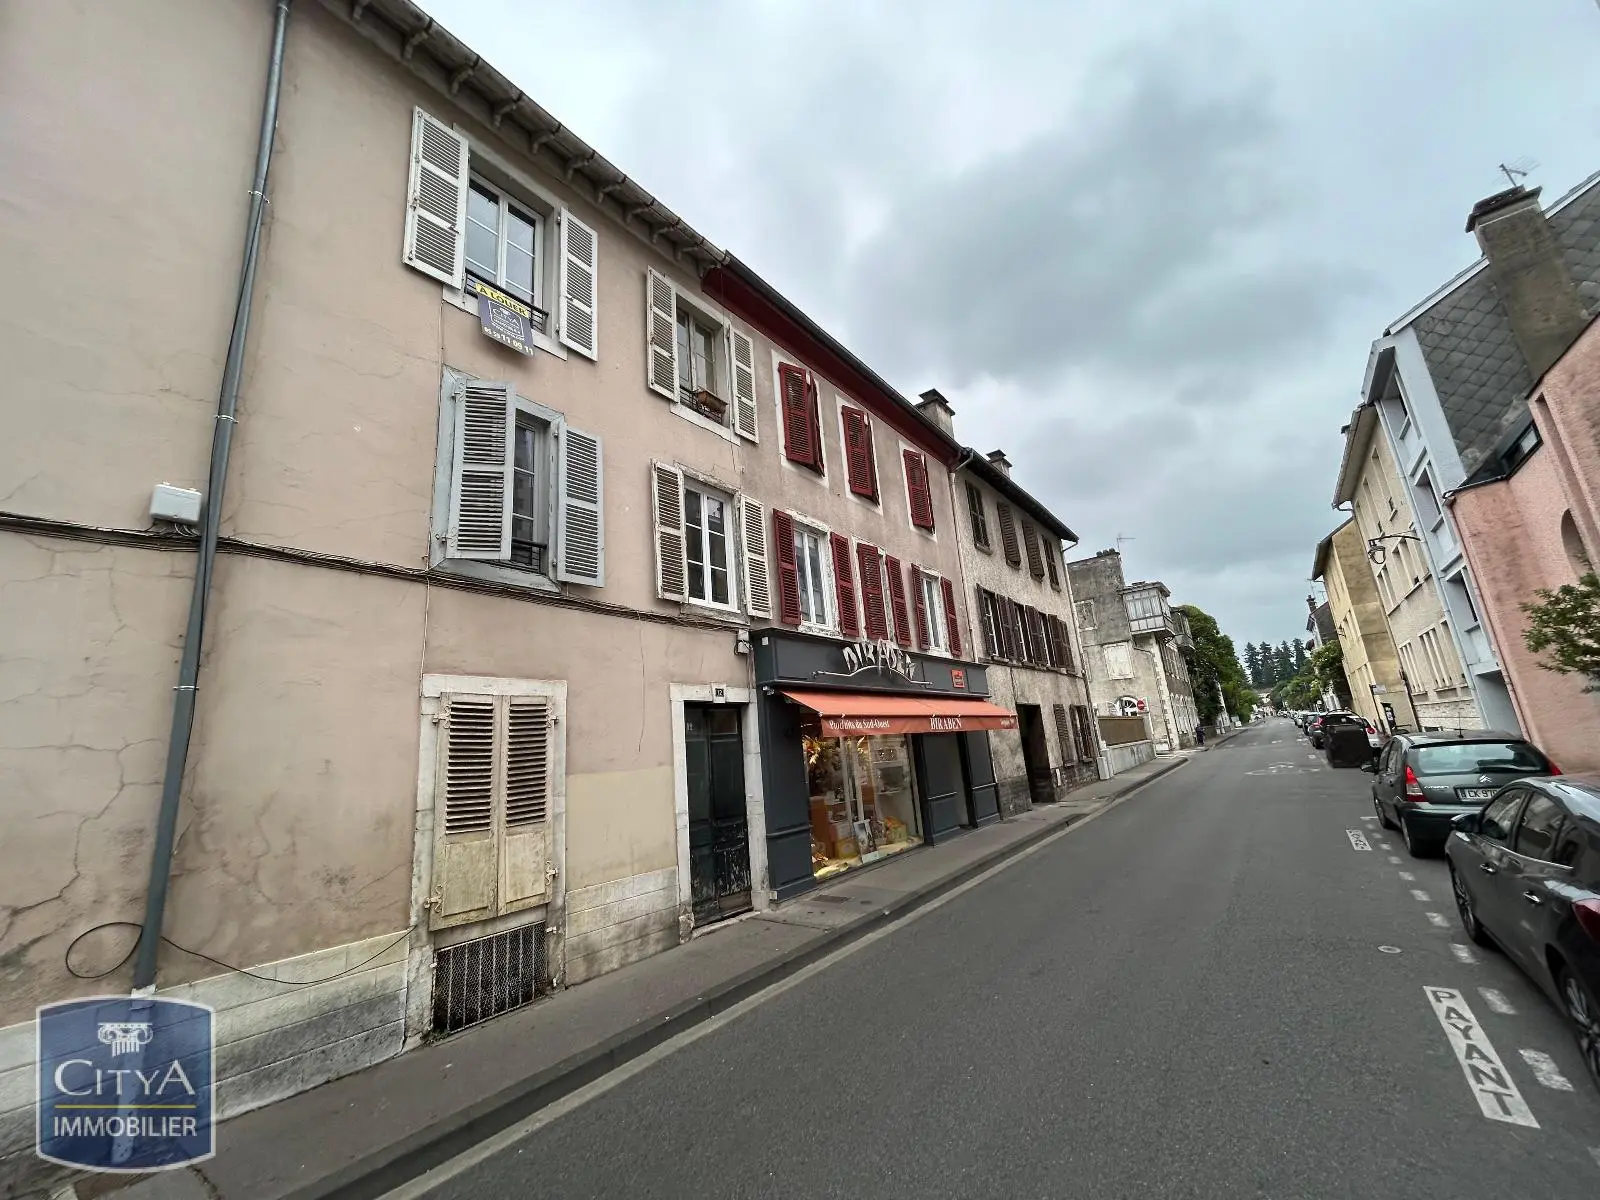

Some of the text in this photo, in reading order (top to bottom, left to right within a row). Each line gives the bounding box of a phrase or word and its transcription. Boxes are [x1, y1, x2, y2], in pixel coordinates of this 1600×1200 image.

[490, 292, 526, 316] LOUER
[501, 334, 511, 344] 11
[512, 341, 523, 350] 09
[524, 345, 534, 355] 11
[930, 717, 962, 730] BIRABEN
[1431, 990, 1515, 1117] PAYANT
